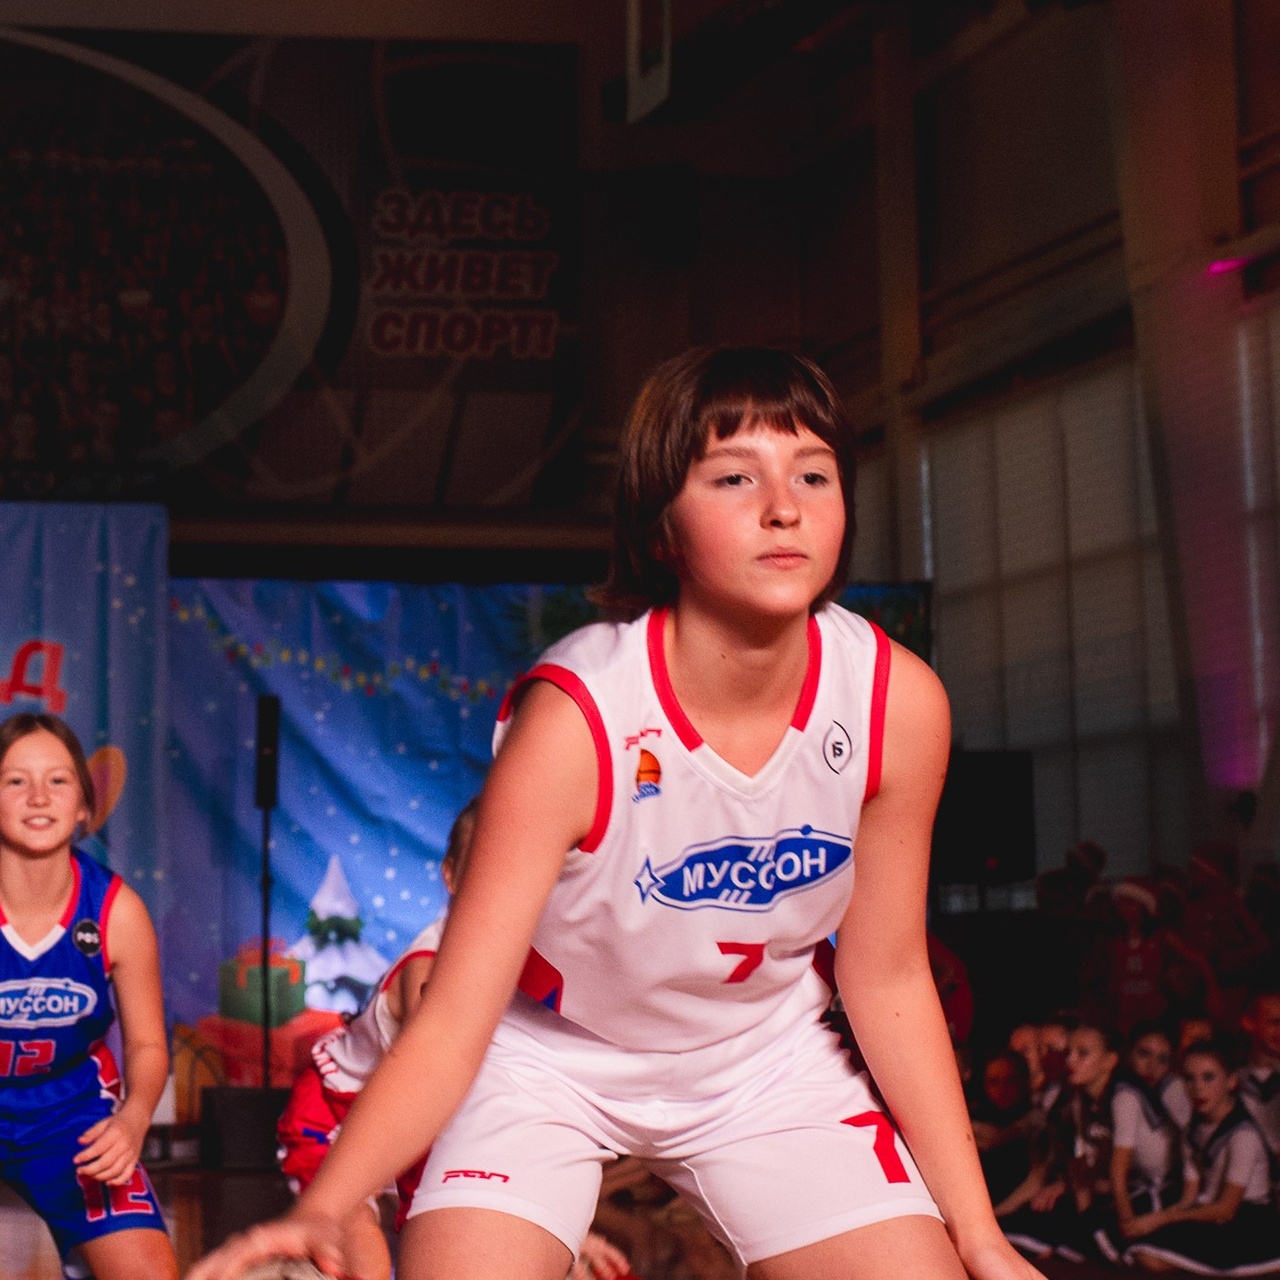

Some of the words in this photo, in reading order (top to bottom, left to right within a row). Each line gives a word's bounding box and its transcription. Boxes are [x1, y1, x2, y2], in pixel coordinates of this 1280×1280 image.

[376, 190, 548, 239] ЗДЕСЬ
[373, 252, 557, 297] ЖИВЕТ
[682, 846, 827, 898] МУССОН
[716, 940, 768, 984] 7
[838, 1109, 912, 1184] 7
